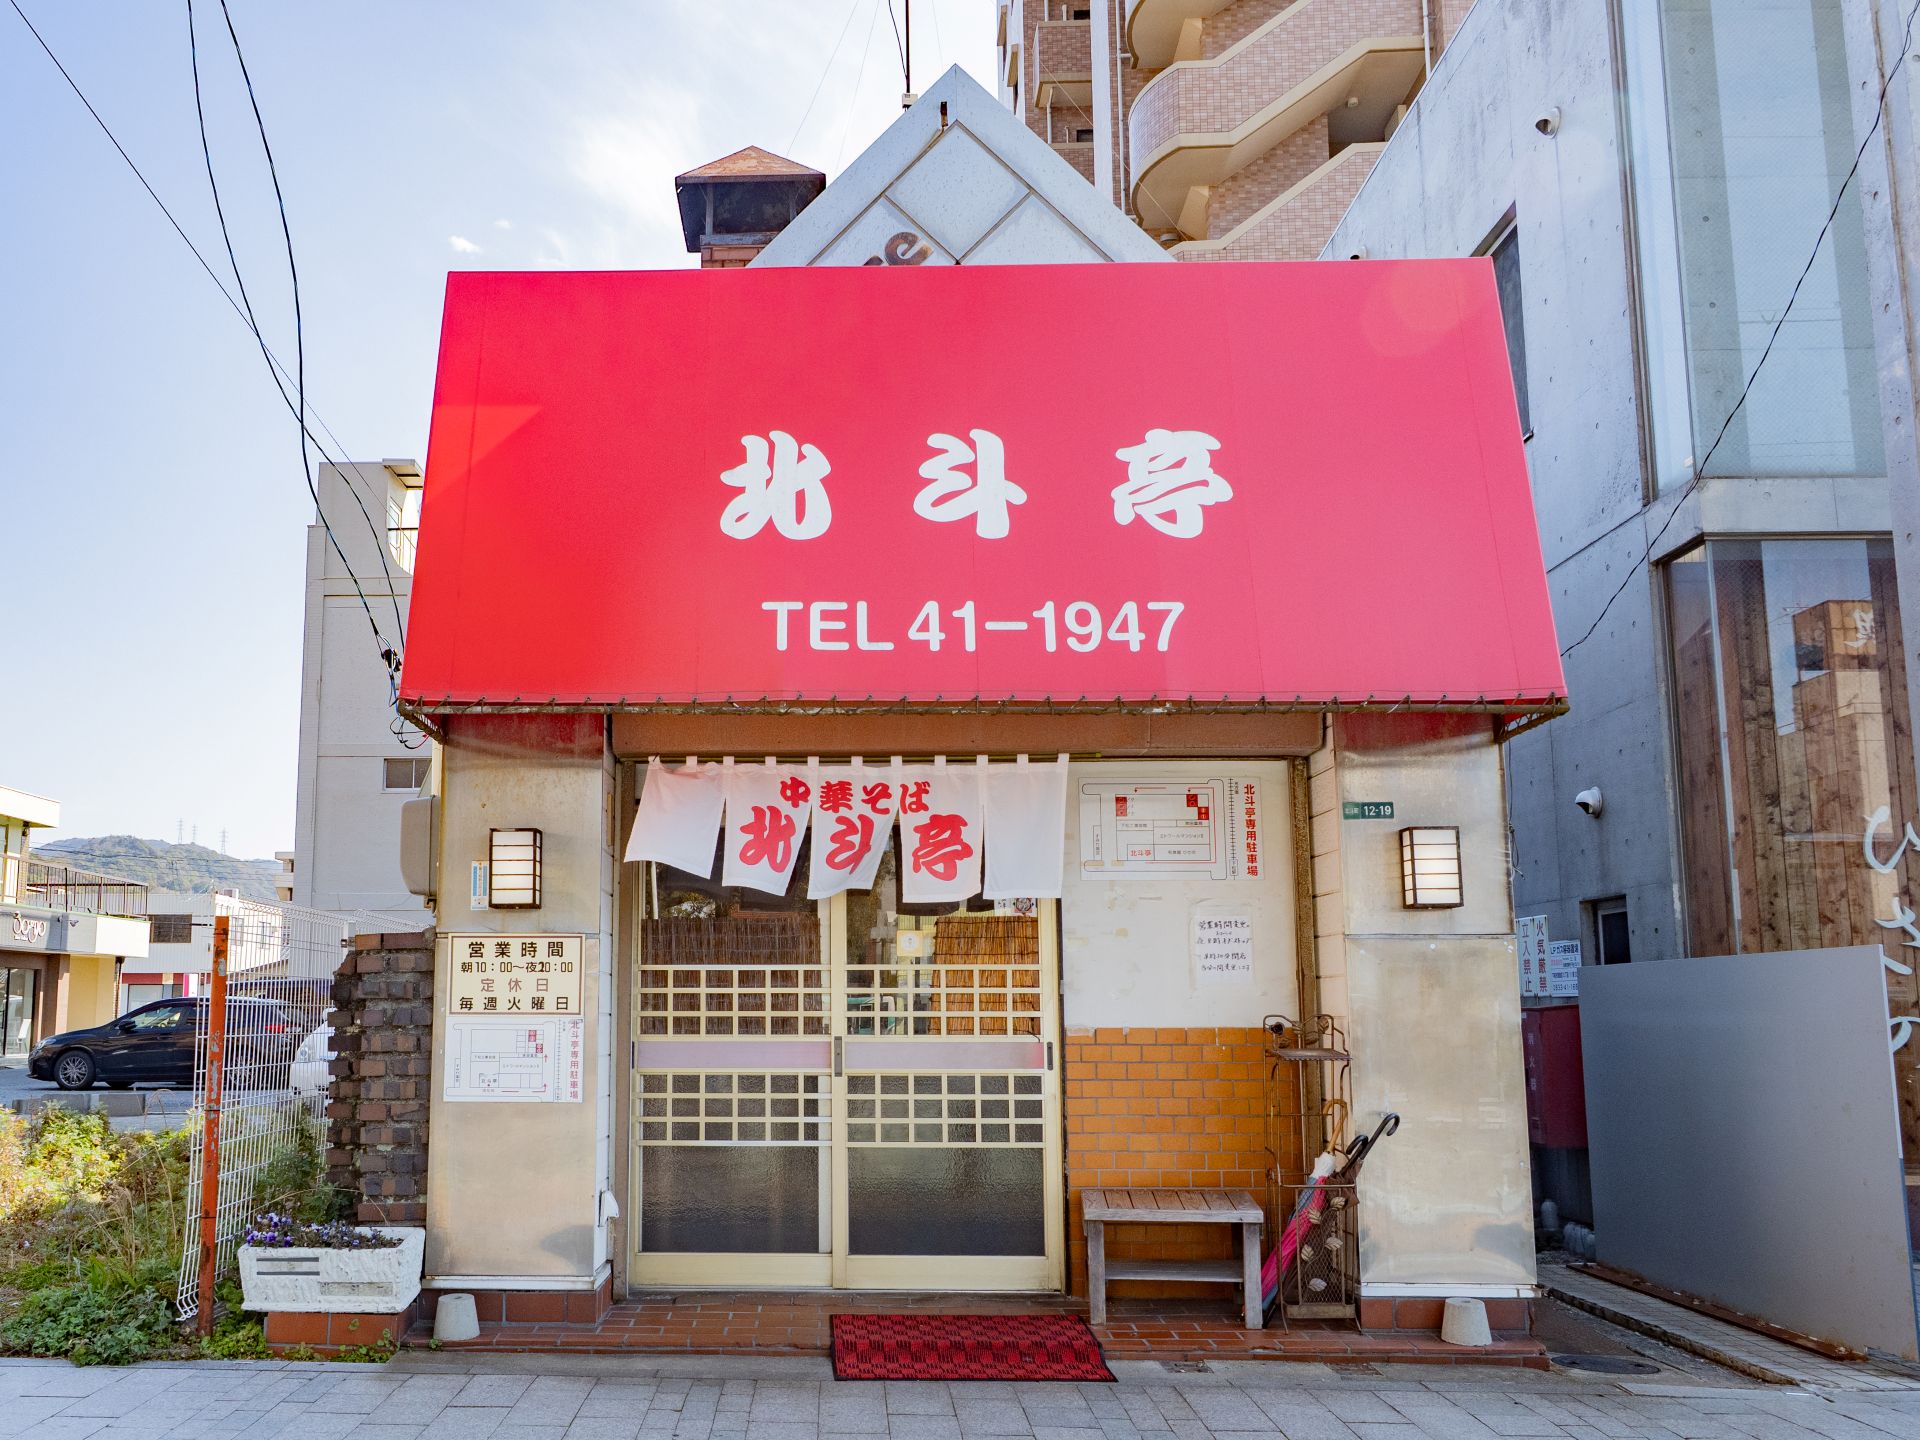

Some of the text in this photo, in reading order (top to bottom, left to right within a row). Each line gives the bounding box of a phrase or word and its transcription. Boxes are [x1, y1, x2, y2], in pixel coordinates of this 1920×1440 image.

[719, 428, 1233, 540] 北斗亭
[761, 600, 894, 651] TEL
[779, 776, 931, 815] 中華そば
[1363, 805, 1392, 816] 12-19
[738, 805, 974, 882] 北斗亭
[1130, 849, 1152, 857] 北斗亭
[1243, 783, 1258, 877] 北斗亭専用駐車場
[468, 941, 564, 958] 営業時間
[1521, 922, 1533, 993] 立入禁止
[1536, 920, 1548, 992] 火気厳禁
[459, 996, 569, 1011] 毎週火曜日
[480, 978, 548, 992] 定休日
[569, 1020, 580, 1100] 北斗亭専用駐車場
